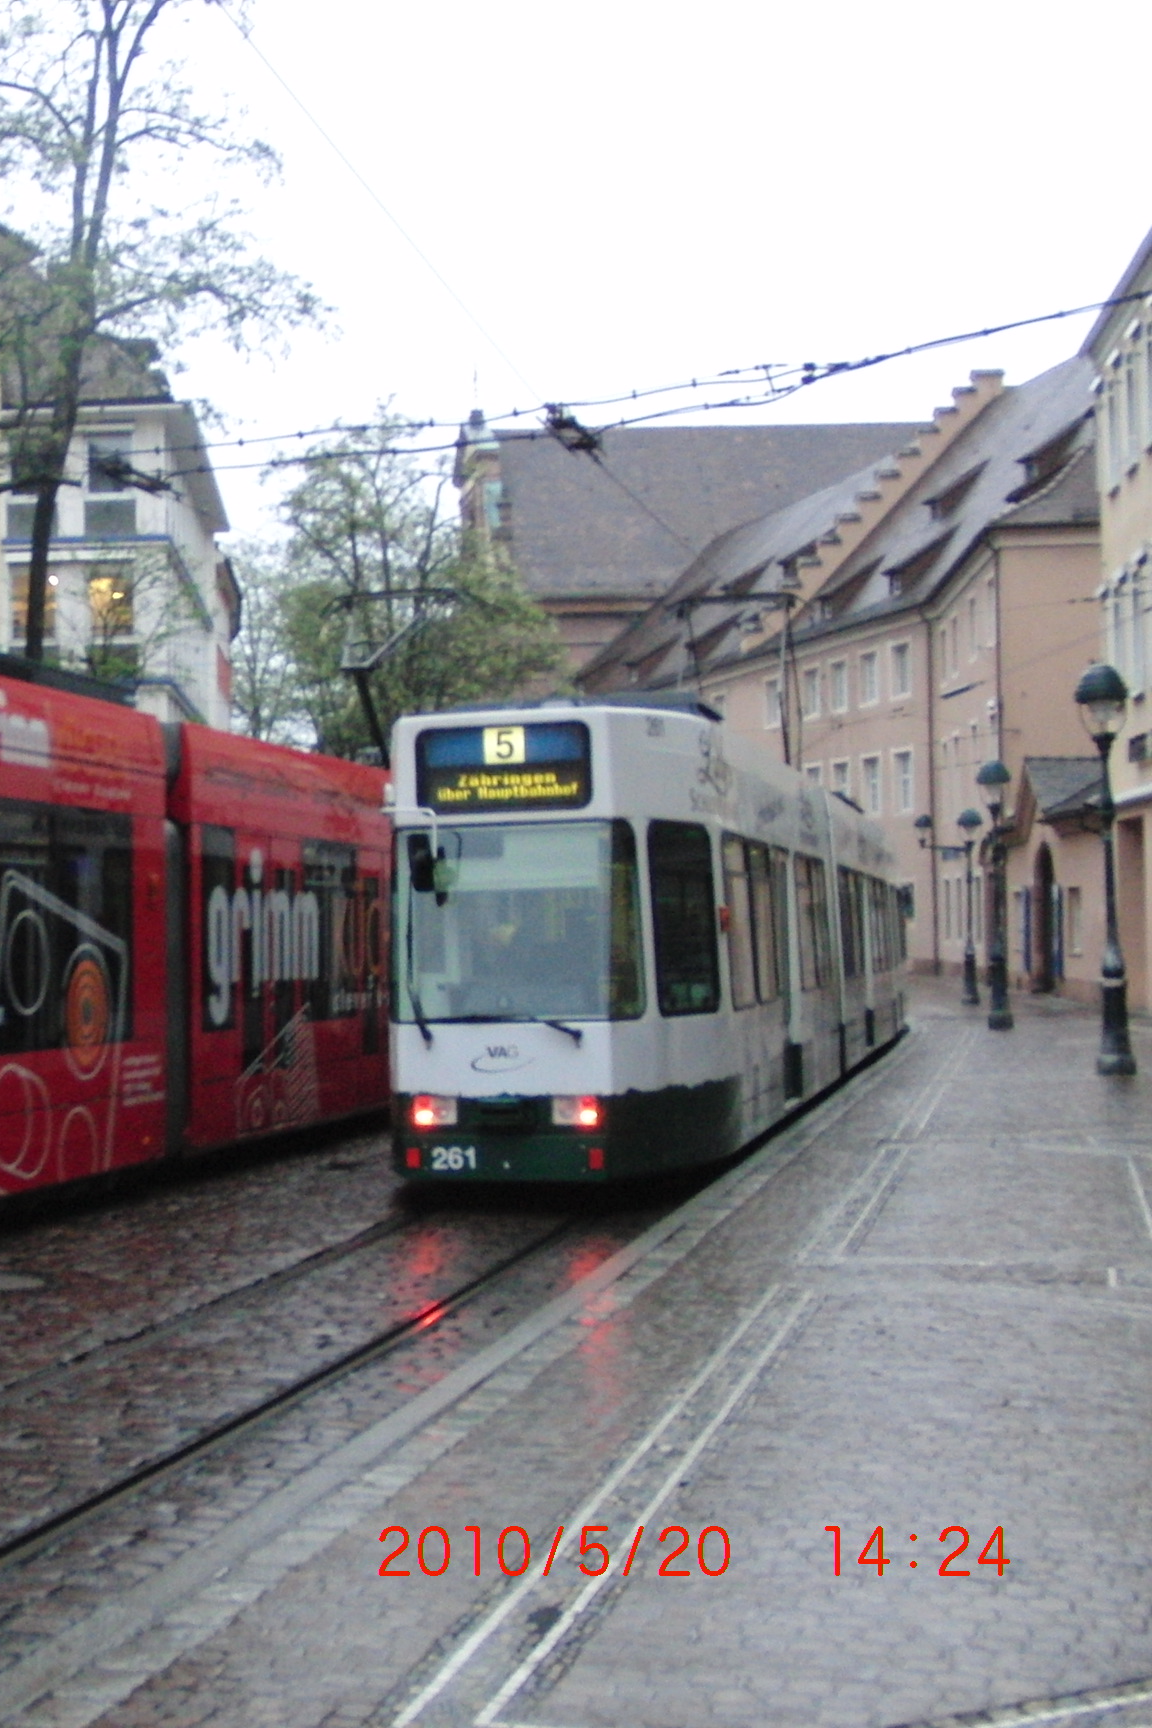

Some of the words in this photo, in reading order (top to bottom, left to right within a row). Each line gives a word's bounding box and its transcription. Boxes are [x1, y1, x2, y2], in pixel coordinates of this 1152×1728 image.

[495, 730, 515, 760] 5
[208, 847, 320, 1026] grimm
[431, 1146, 477, 1171] 261
